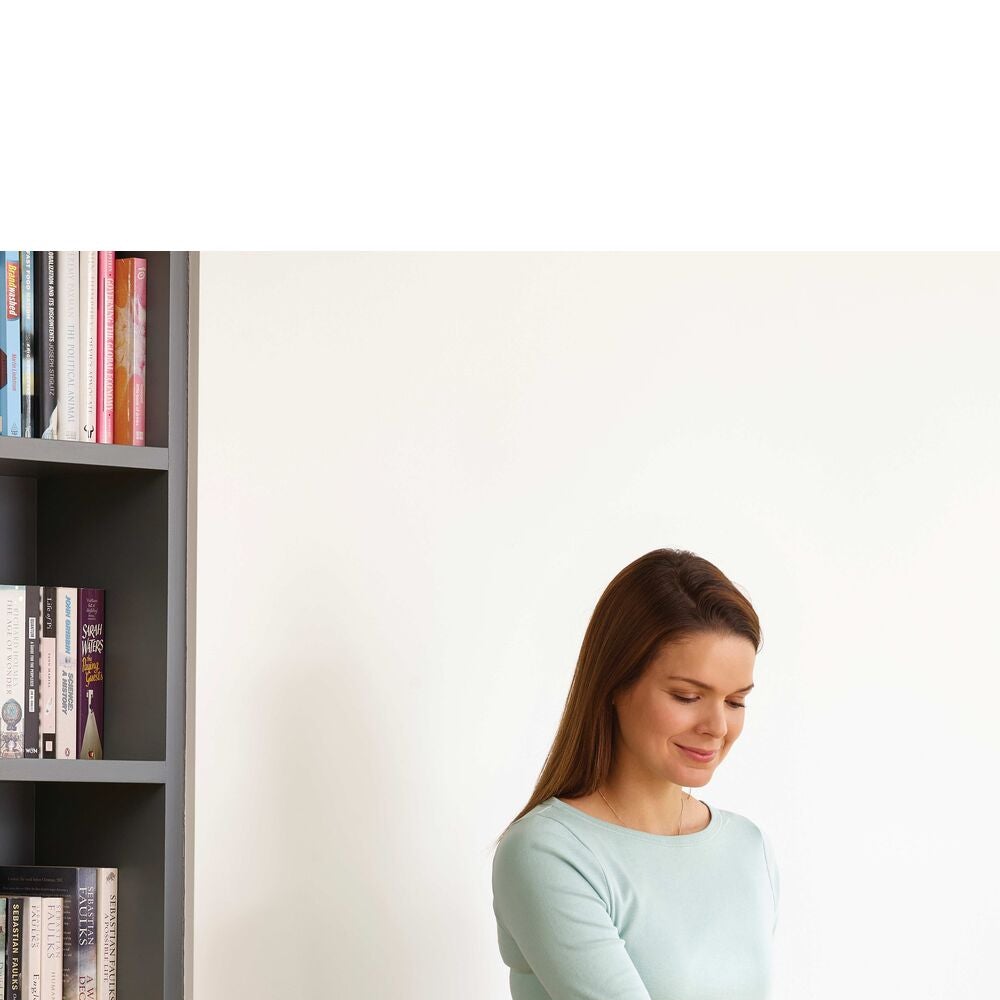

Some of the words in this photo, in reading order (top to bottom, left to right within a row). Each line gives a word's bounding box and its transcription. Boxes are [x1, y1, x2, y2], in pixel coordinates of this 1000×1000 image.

[8, 264, 18, 316] Brandwashed
[106, 278, 114, 322] GOVERNING
[67, 325, 75, 340] THE
[106, 325, 114, 340] THE
[67, 343, 75, 387] POLITICAL
[106, 342, 114, 374] GLOBAL
[106, 375, 114, 412] ECONOMY
[67, 390, 75, 423] ANIMAL
[46, 613, 53, 621] of
[46, 622, 53, 630] Pi
[82, 624, 103, 639] SARAH
[6, 640, 13, 650] OF
[82, 638, 104, 656] WATERS
[79, 887, 88, 946] FAULKS
[47, 904, 56, 959] FAULKS
[86, 975, 94, 983] A
